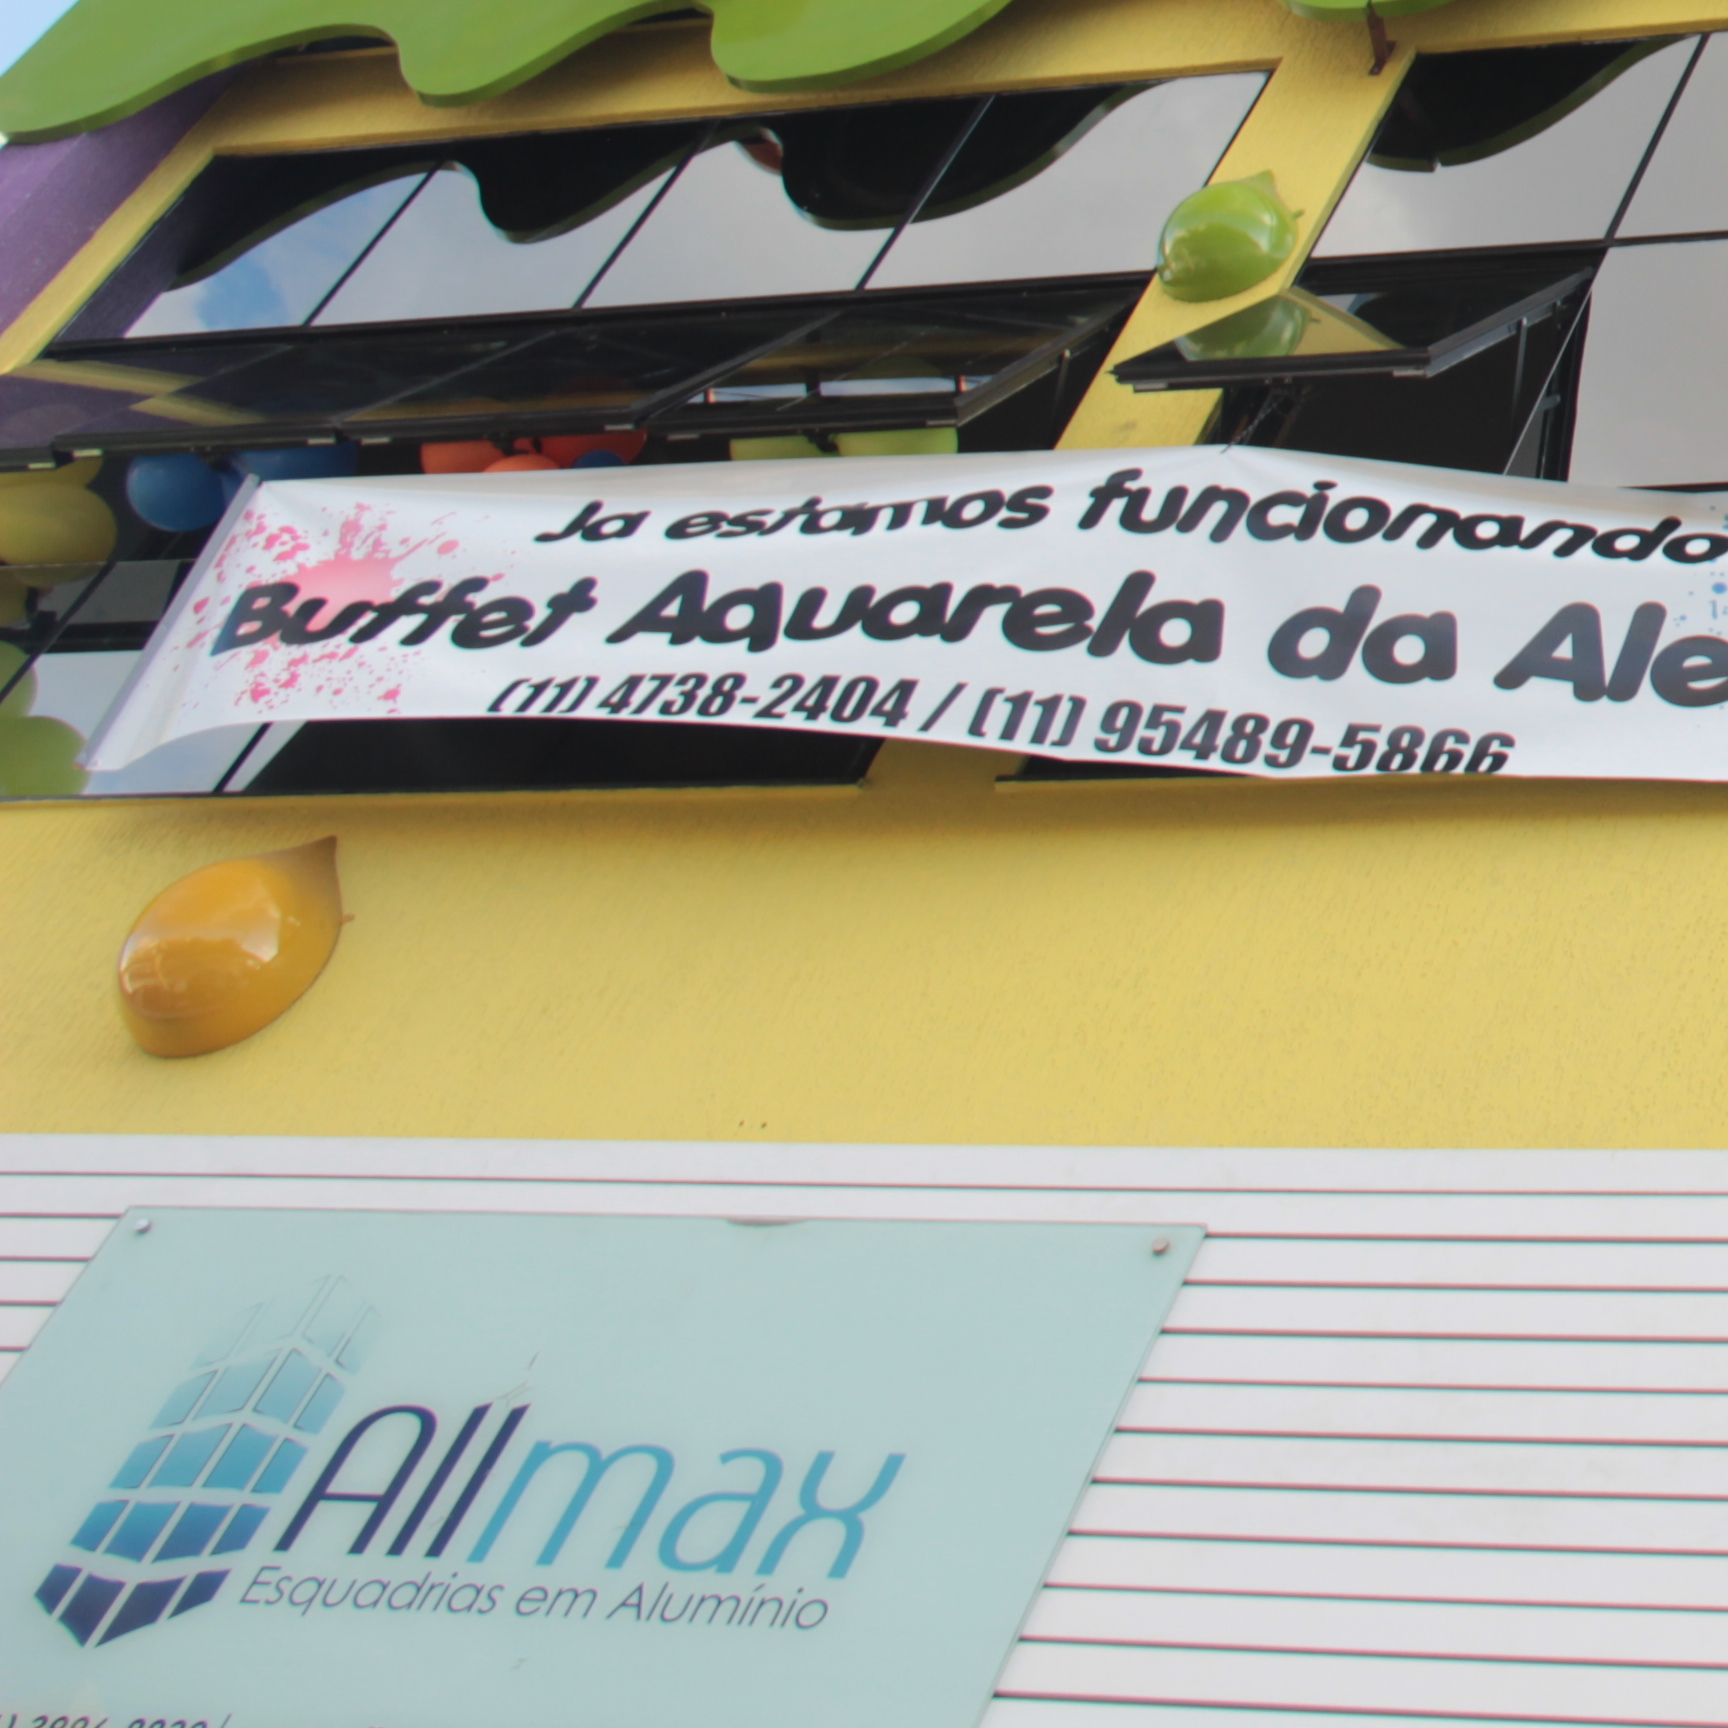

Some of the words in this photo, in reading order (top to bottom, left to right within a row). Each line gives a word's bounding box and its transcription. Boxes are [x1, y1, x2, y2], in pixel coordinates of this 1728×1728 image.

[664, 485, 1055, 540] estamos
[210, 576, 598, 656] Buffet
[605, 568, 1224, 666] Aquarela
[1267, 584, 1458, 684] da
[487, 675, 600, 715] (11)
[596, 672, 920, 728] 4738-2404
[968, 687, 1087, 748] (11)
[1092, 700, 1516, 774] 95489-5866
[272, 1403, 906, 1580] Allmax
[240, 1565, 504, 1619] Esquadrias
[516, 1584, 597, 1621] em
[606, 1580, 830, 1633] Alumínio
